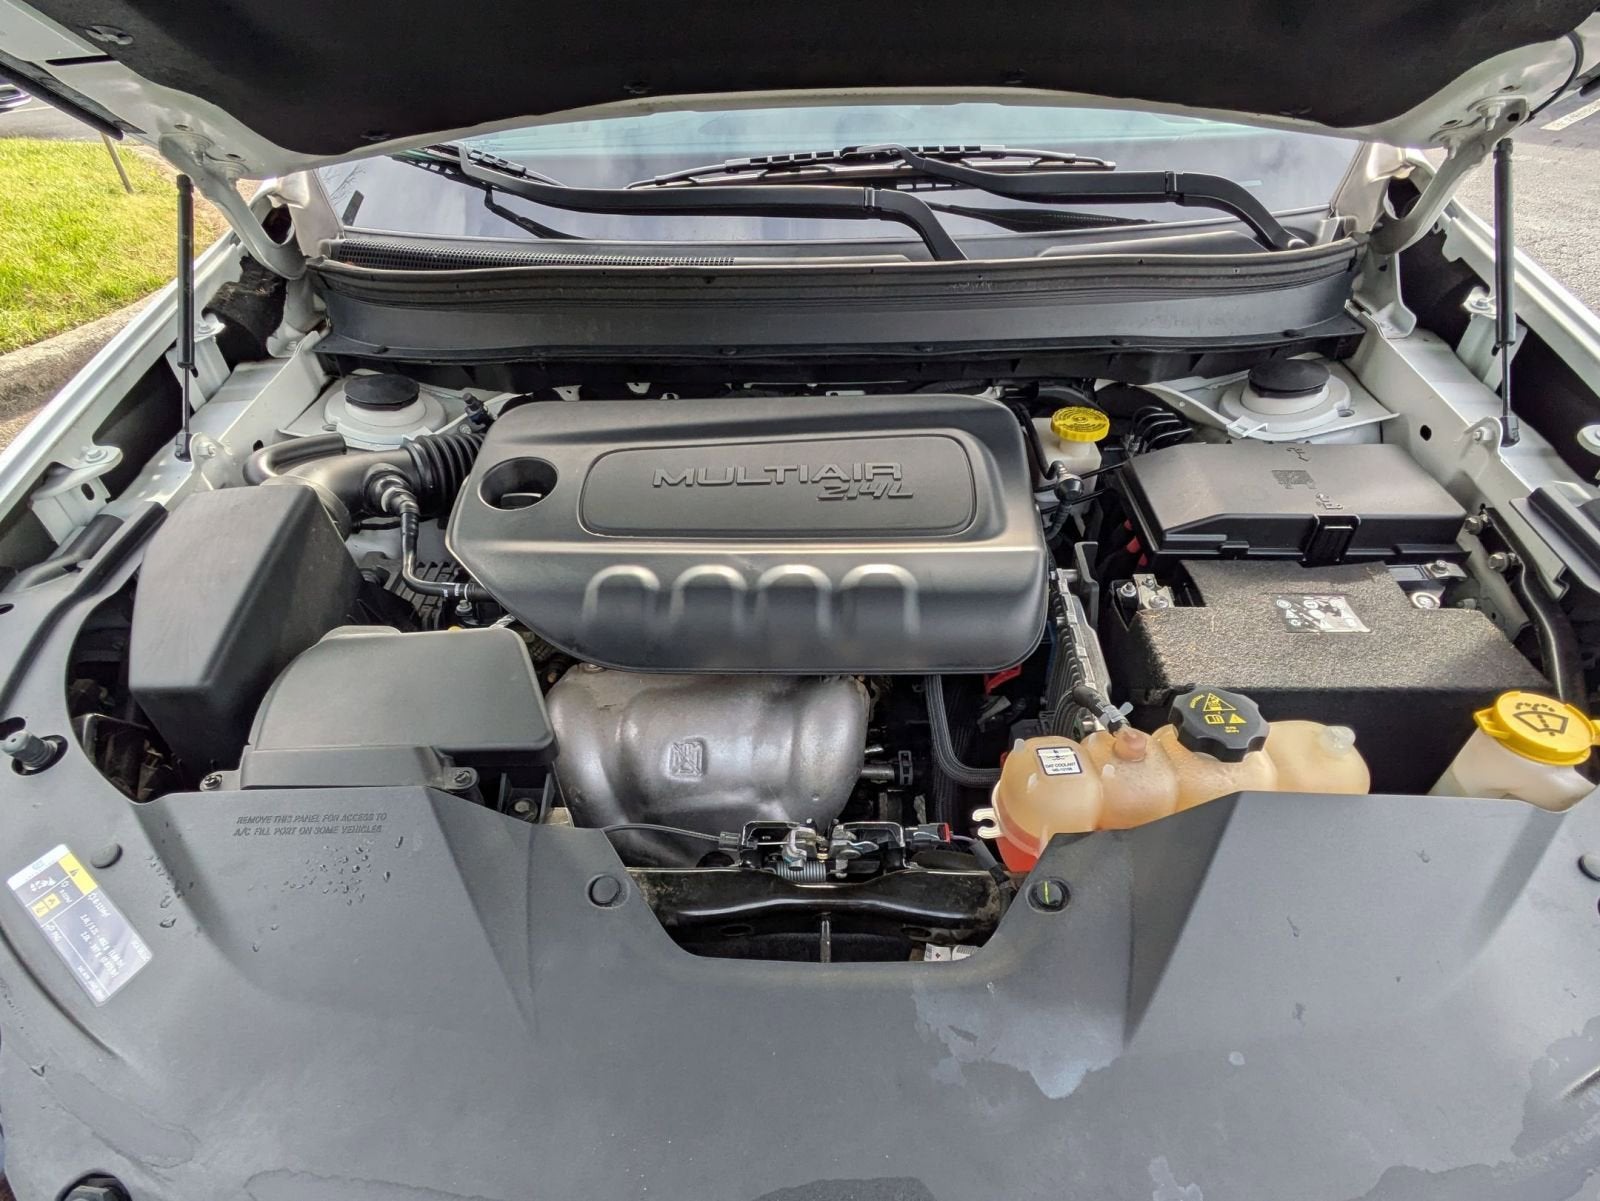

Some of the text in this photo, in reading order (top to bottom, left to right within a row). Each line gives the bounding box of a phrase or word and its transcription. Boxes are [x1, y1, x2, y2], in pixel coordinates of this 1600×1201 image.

[652, 462, 903, 488] MULTIAIR
[236, 812, 387, 825] REMOVE THIS PANEL FOR ACCESS TO
[254, 827, 272, 836] FILL
[273, 826, 298, 836] PORT
[299, 826, 313, 835] ON
[313, 826, 340, 834] SOME
[341, 824, 382, 834] VEHICLES
